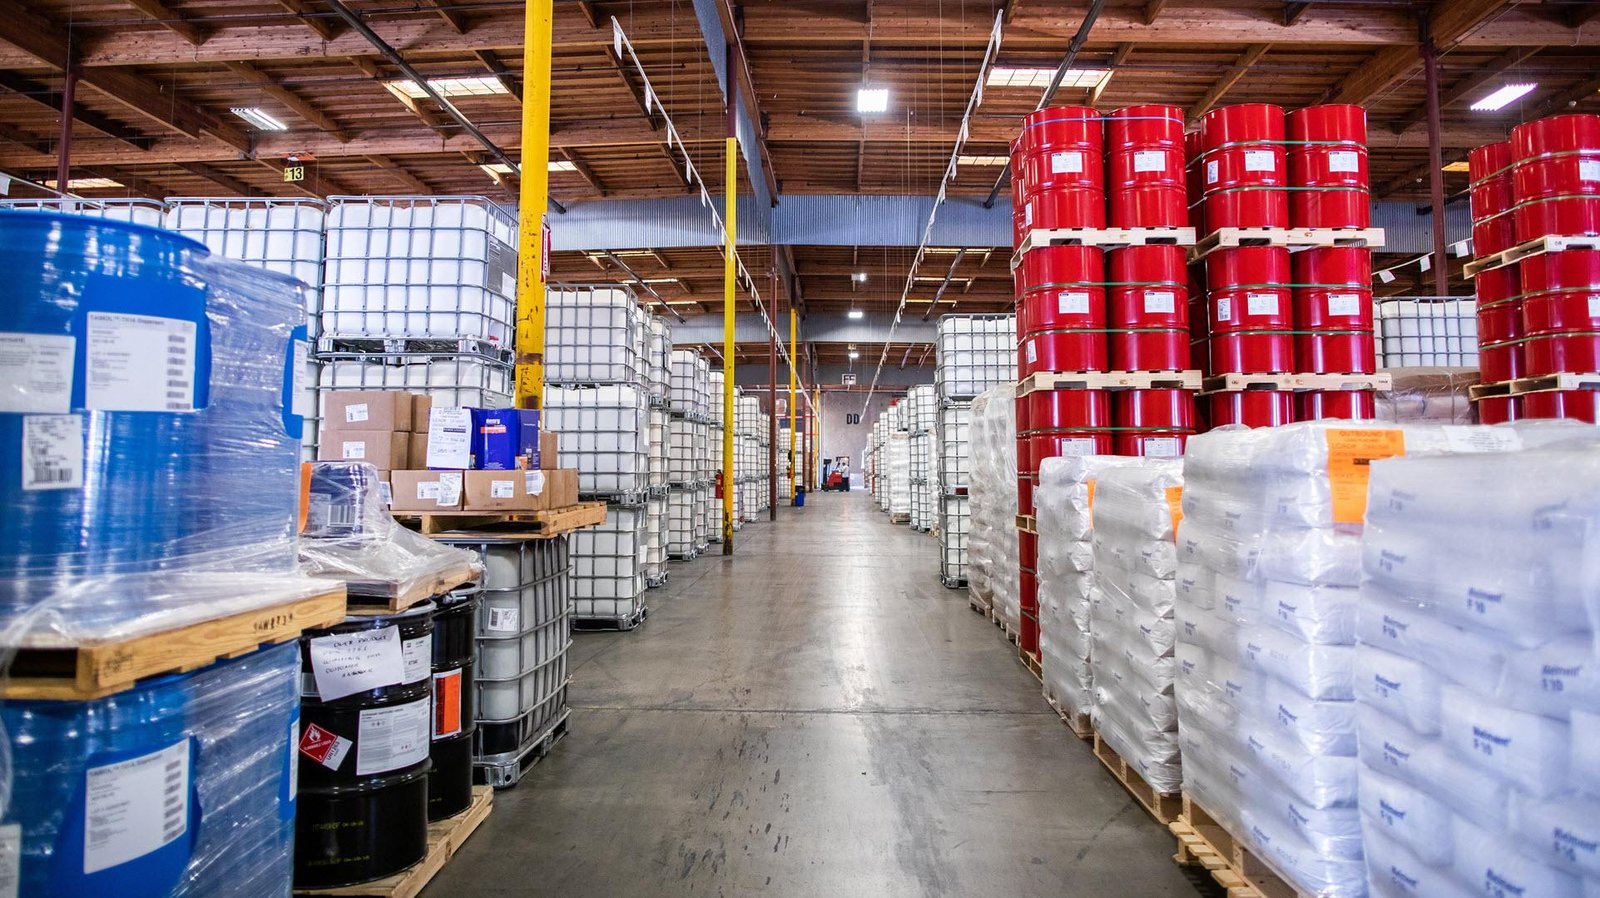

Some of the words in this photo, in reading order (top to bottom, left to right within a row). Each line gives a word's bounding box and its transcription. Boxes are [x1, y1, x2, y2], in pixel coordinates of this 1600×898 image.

[290, 168, 302, 180] 13
[843, 375, 855, 384] FF
[846, 413, 860, 425] DD
